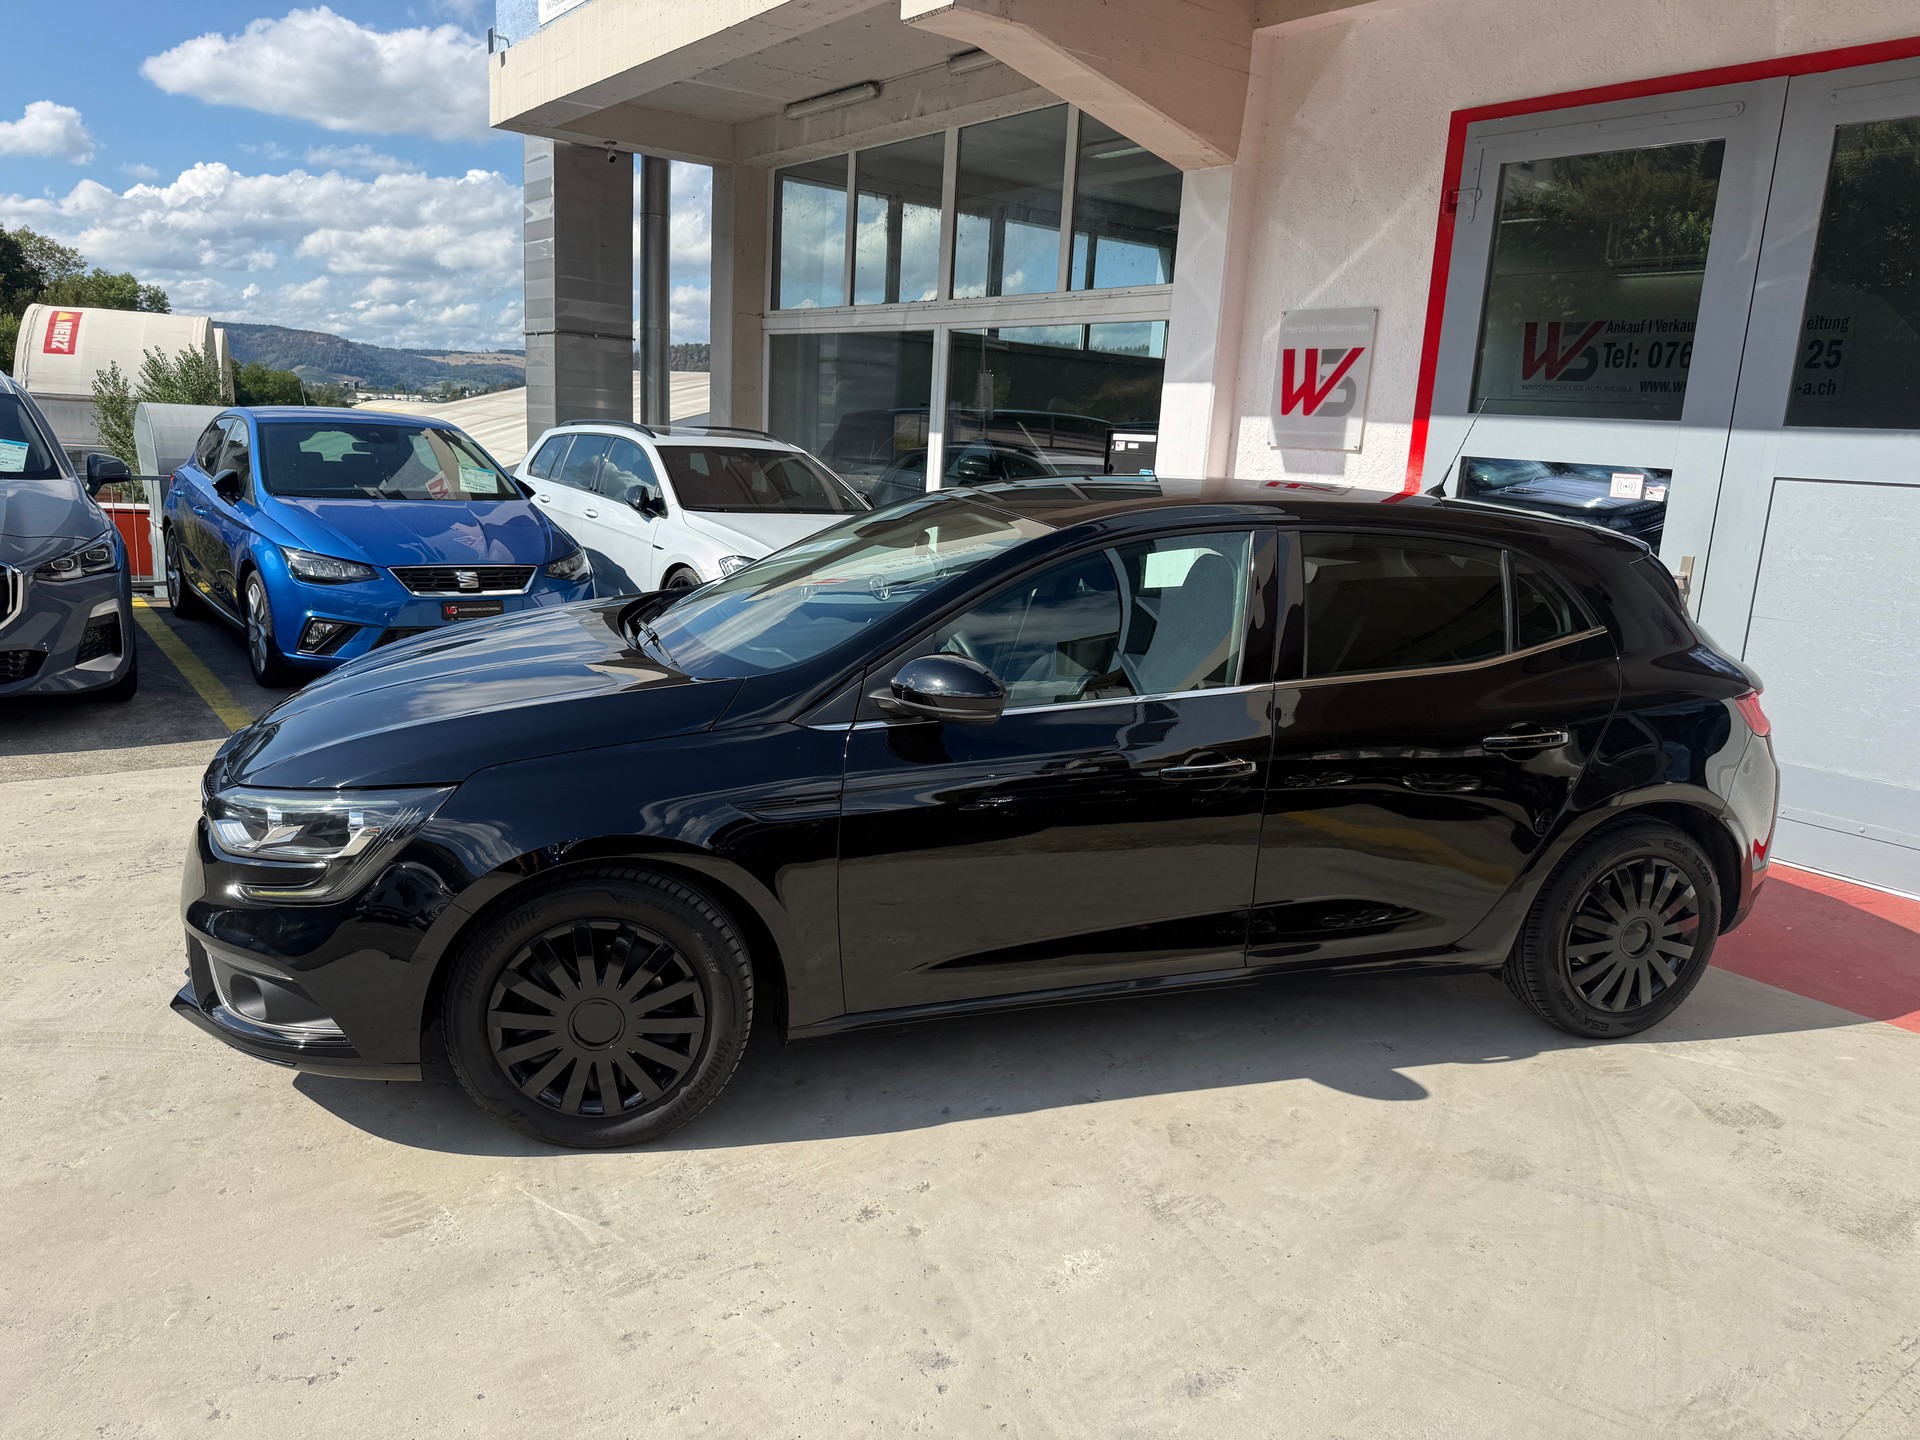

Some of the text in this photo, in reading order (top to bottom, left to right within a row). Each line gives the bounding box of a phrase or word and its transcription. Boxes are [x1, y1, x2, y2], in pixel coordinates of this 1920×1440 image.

[50, 321, 73, 350] MERZ
[1284, 323, 1369, 334] Herzlich Willkommen
[1605, 319, 1647, 334] Ankauf
[1806, 315, 1851, 333] eitung
[1603, 341, 1693, 369] Tel: 076
[1804, 339, 1844, 369] 25
[1585, 384, 1634, 393] AUTOMOBILE
[458, 903, 541, 1001] BRIDGESTONE
[649, 1036, 733, 1128] BRIDGESTONE
